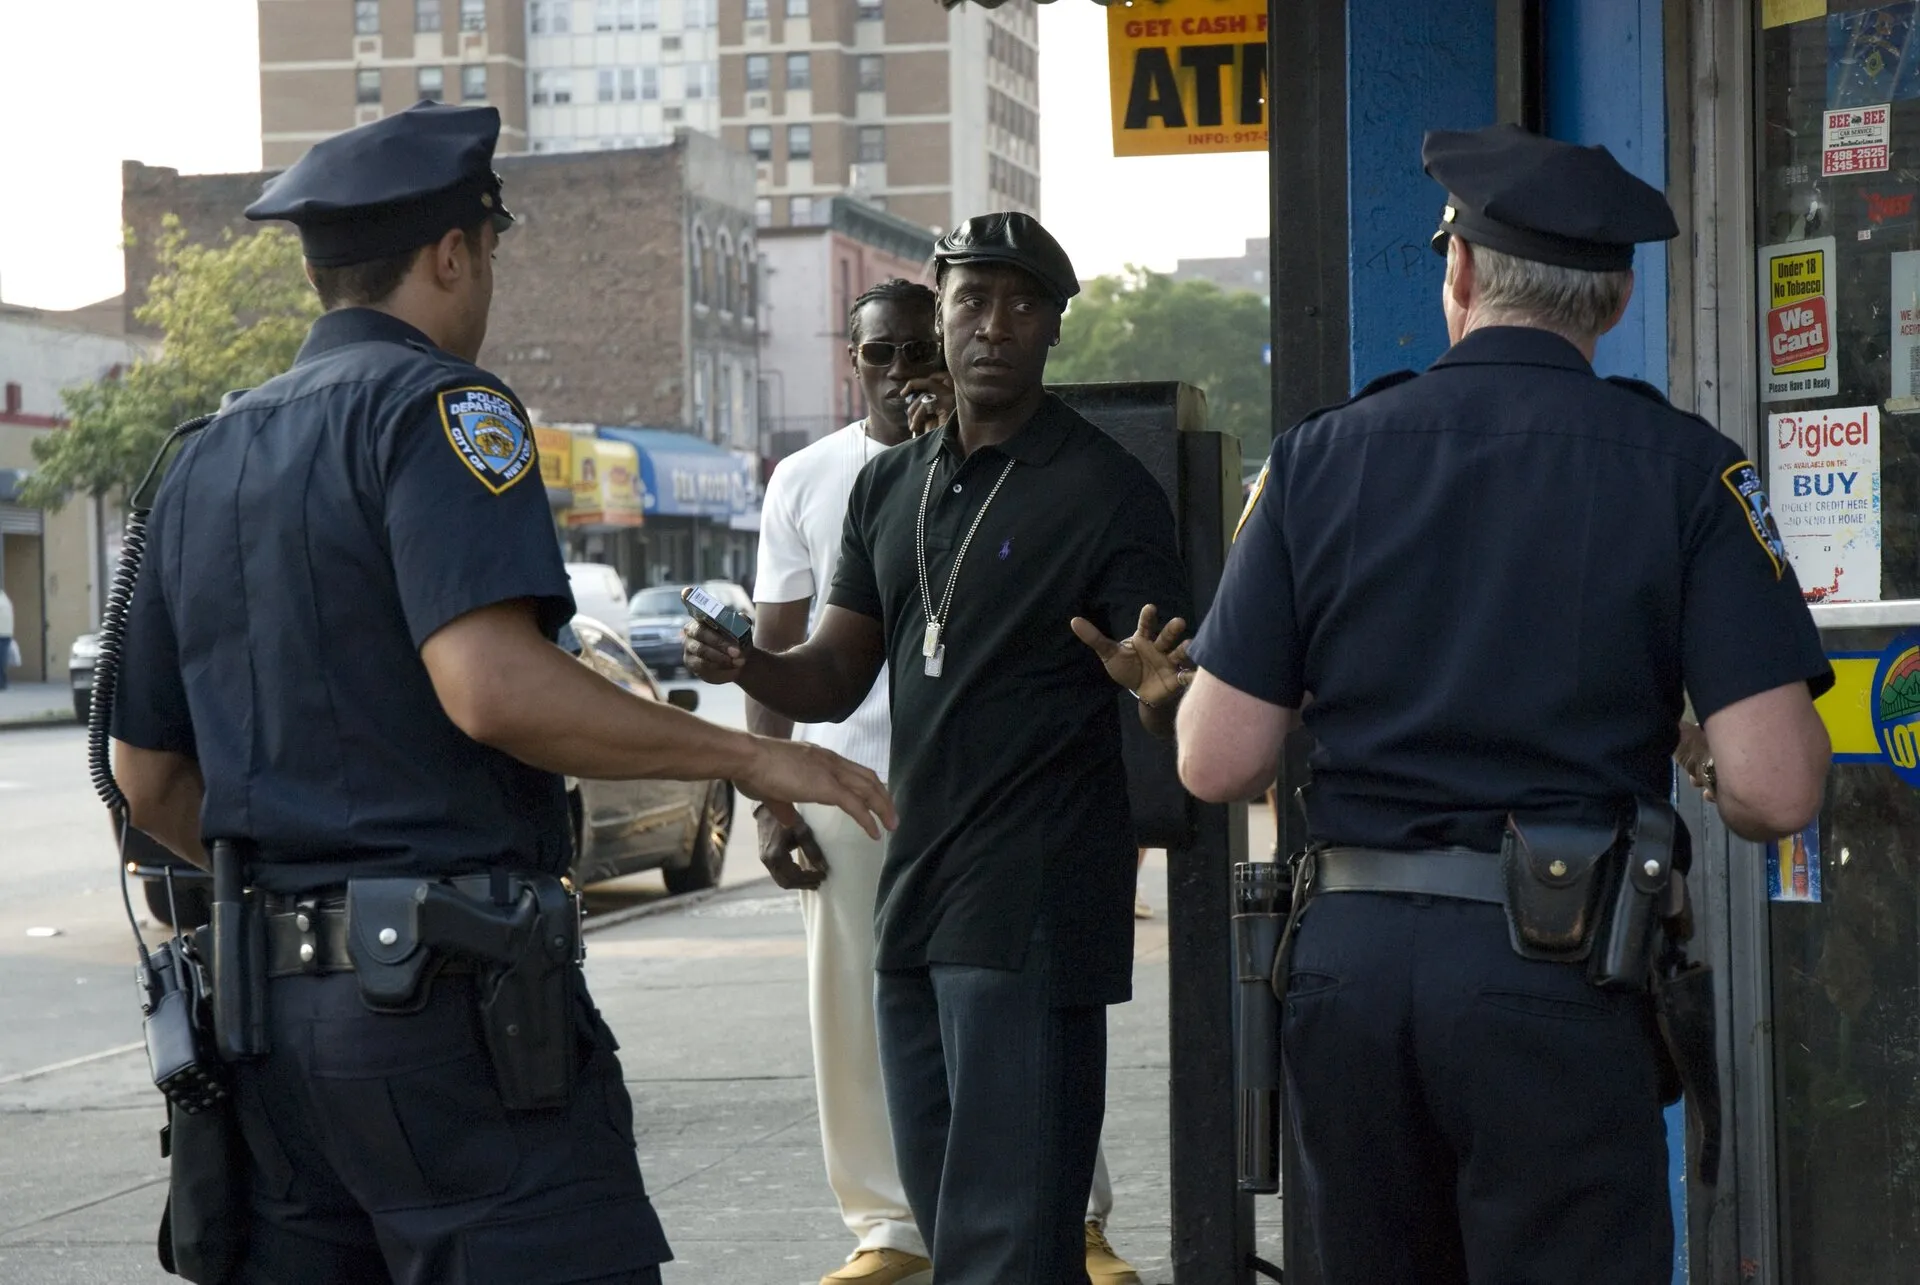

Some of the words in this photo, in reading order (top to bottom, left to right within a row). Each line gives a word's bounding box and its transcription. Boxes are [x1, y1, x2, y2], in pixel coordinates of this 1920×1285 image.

[1125, 19, 1171, 37] GET
[1181, 15, 1246, 35] CASH
[1829, 113, 1850, 128] BEE
[1863, 110, 1885, 125] BEE
[1188, 133, 1229, 145] INFO:
[1851, 127, 1872, 135] SERVICE
[1832, 147, 1885, 160] 498-2525
[1832, 157, 1885, 171] 345-1111
[1778, 262, 1804, 278] Under
[1806, 258, 1816, 274] 18
[1774, 282, 1785, 298] No
[1787, 280, 1821, 296] Tobacco
[1779, 307, 1815, 332] We
[1901, 310, 1912, 321] WE
[1772, 323, 1824, 355] Card
[1768, 383, 1788, 393] Please
[1789, 380, 1803, 391] Have
[1805, 379, 1811, 389] ID
[1813, 377, 1830, 389] Ready
[466, 392, 512, 411] POLICE
[450, 402, 526, 431] DEPARTMENT
[1778, 412, 1868, 457] Digicel
[451, 427, 473, 453] CITY
[469, 454, 487, 472] OF
[503, 460, 523, 480] NEW
[1793, 472, 1858, 497] BUY
[1816, 500, 1844, 511] CREDIT
[1847, 499, 1868, 509] HERE
[1828, 515, 1835, 524] IT
